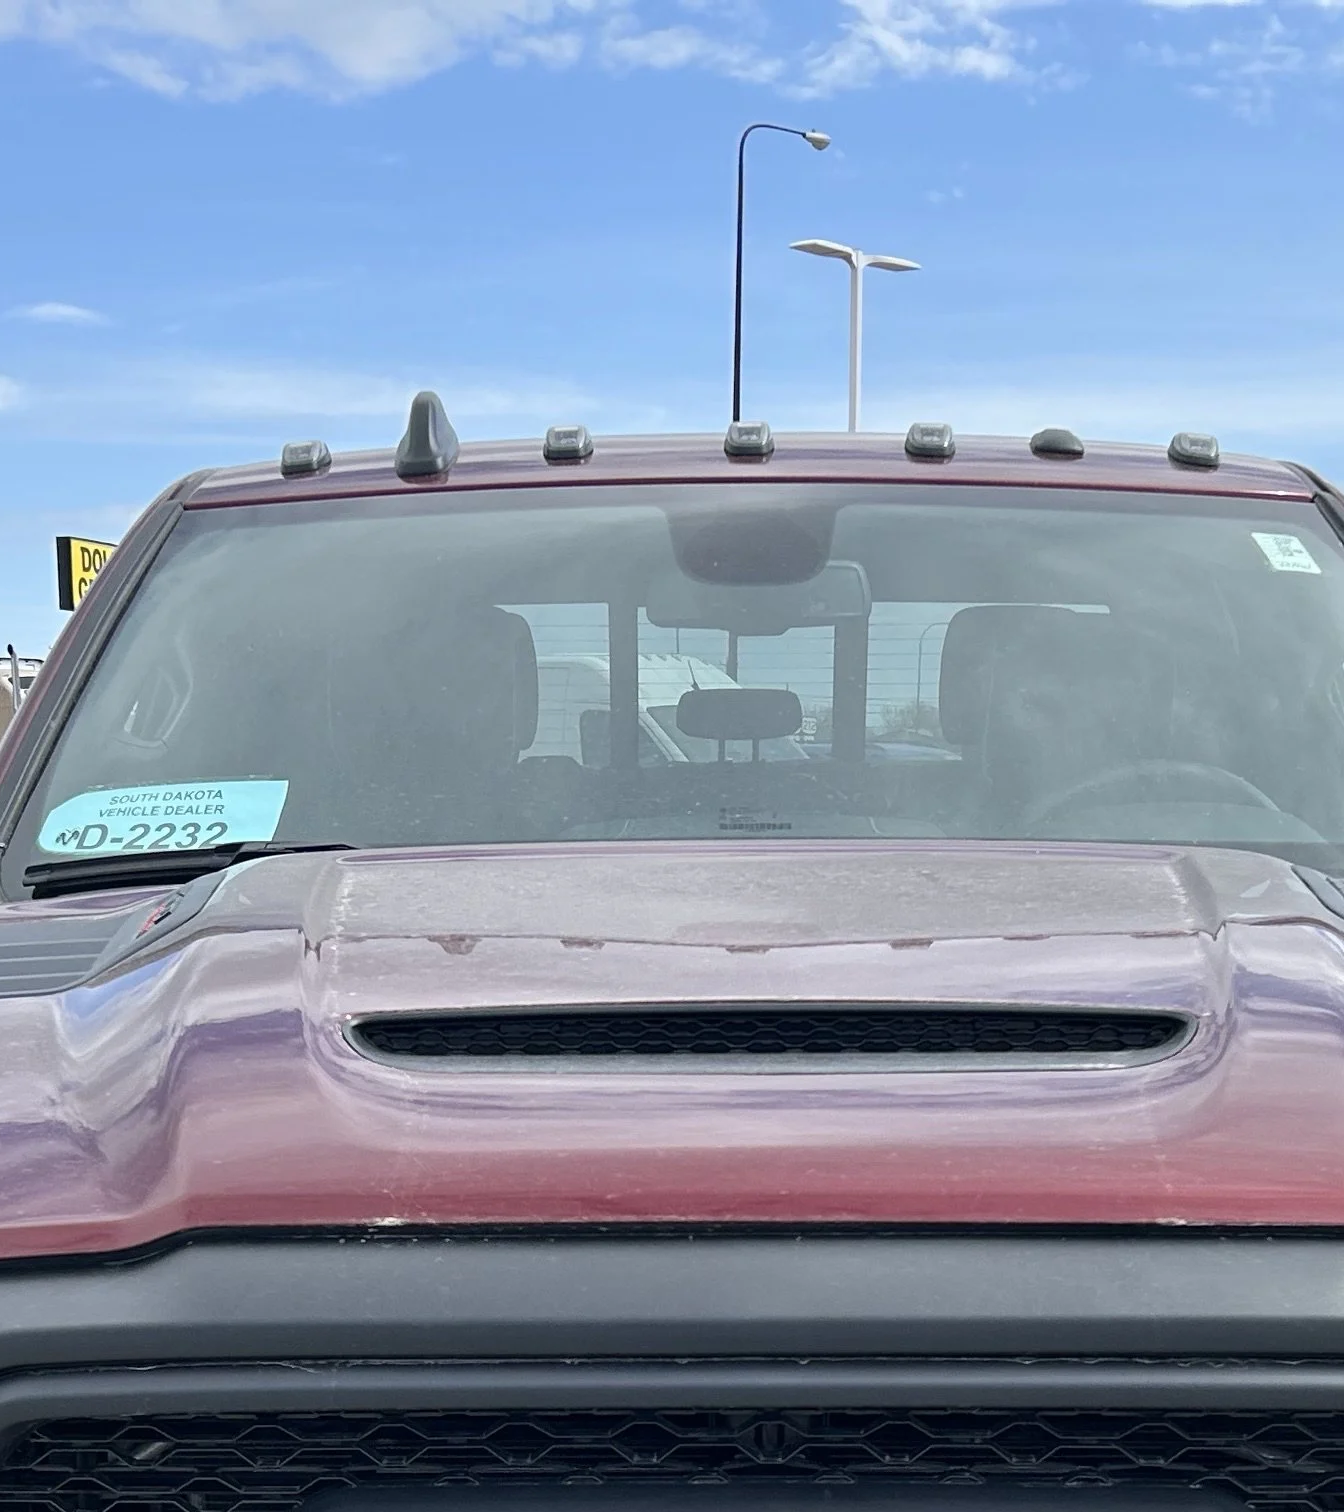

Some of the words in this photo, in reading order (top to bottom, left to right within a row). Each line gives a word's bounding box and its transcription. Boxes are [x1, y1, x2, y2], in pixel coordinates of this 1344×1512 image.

[109, 792, 161, 805] SOUTH
[162, 789, 224, 801] DAKOTA
[99, 806, 161, 818] VEHICLE
[163, 804, 225, 816] DEALER
[75, 822, 229, 850] D-2232
